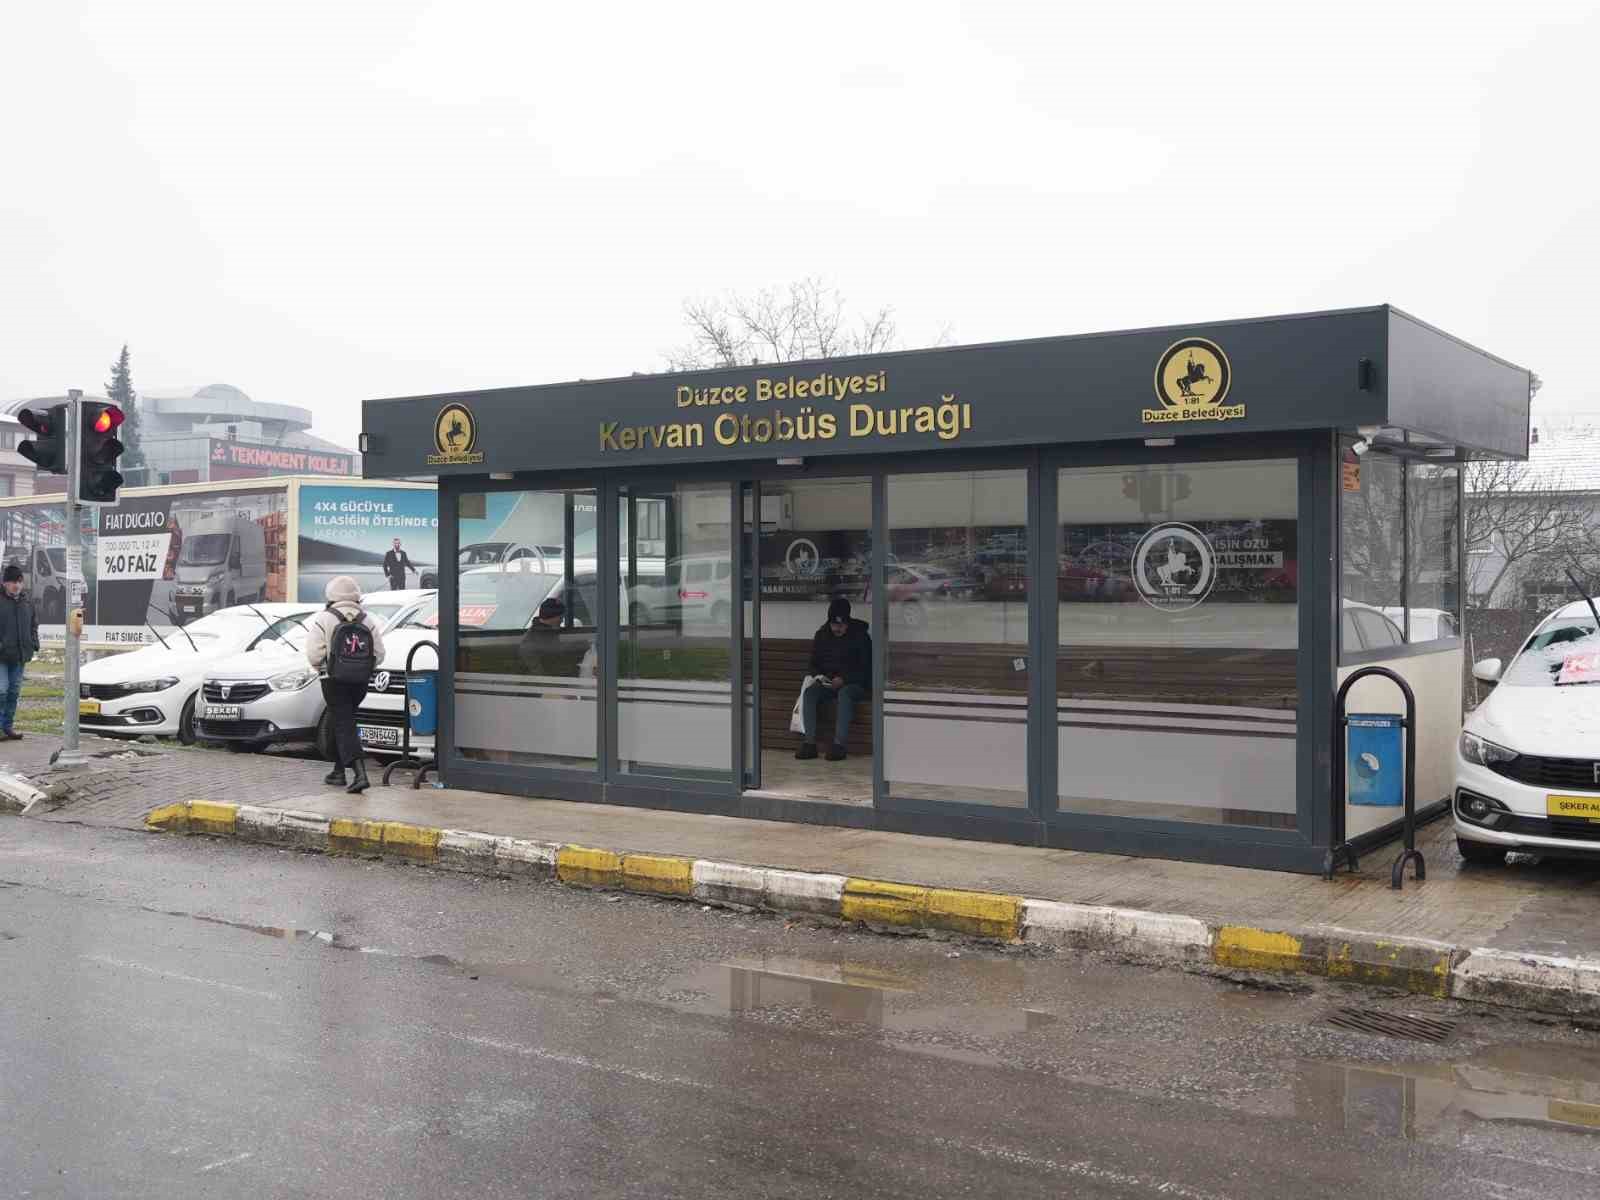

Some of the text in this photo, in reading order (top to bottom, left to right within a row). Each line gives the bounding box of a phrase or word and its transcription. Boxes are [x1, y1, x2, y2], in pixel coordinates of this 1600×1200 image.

[676, 370, 887, 408] Düzce Belediyesi
[600, 393, 972, 451] Kervan Otobüs Durağı
[229, 445, 307, 470] TEKNOKENT
[313, 500, 394, 513] 4X4 GÜCÜYLE
[105, 511, 165, 529] FIAT DUCATO
[104, 554, 126, 573] %0
[105, 631, 120, 641] FIAT
